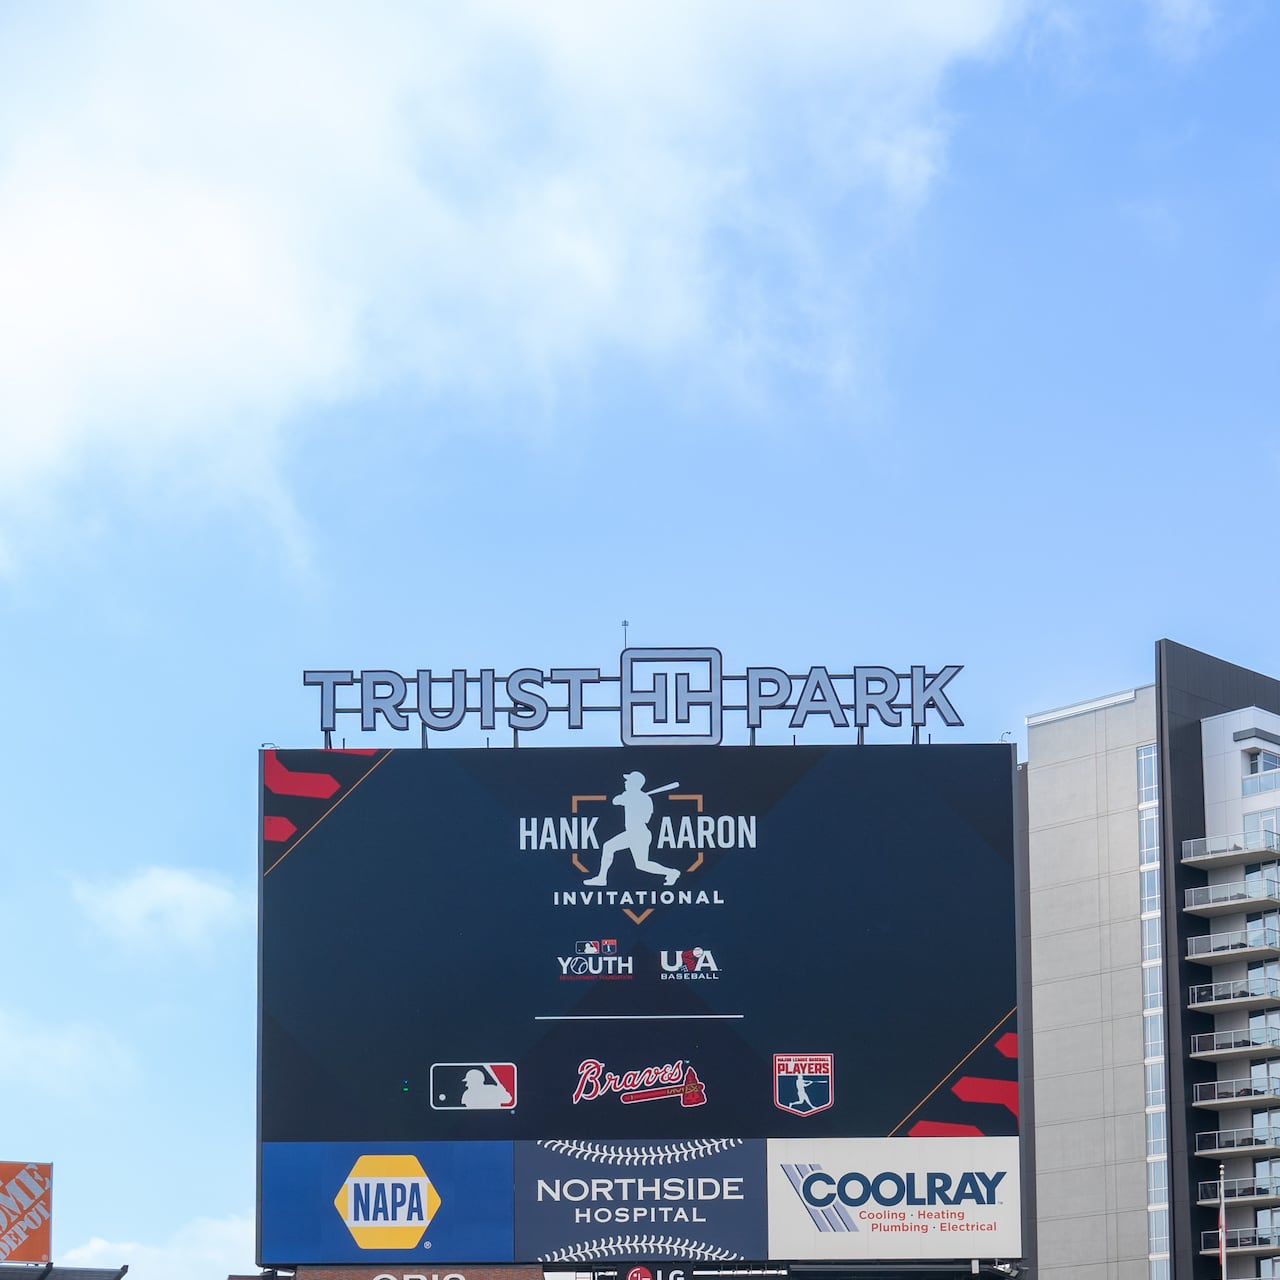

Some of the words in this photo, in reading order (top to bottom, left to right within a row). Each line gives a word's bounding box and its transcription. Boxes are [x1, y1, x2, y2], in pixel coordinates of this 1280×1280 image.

[303, 667, 601, 732] TRUIST
[747, 665, 965, 729] PARK
[520, 817, 599, 850] HANK
[658, 815, 757, 849] AARON
[553, 890, 724, 905] INVITATIONAL
[778, 1063, 829, 1074] PLAYERS
[573, 1059, 683, 1104] Braves
[537, 1178, 744, 1202] NORTHSIDE
[802, 1172, 1007, 1207] COOLRAY
[353, 1183, 424, 1221] NAPA
[575, 1208, 706, 1223] HOSPITAL
[859, 1210, 906, 1221] Cooling
[918, 1210, 965, 1220] Heating
[871, 1223, 928, 1233] Plumbing
[940, 1222, 997, 1232] Electrical
